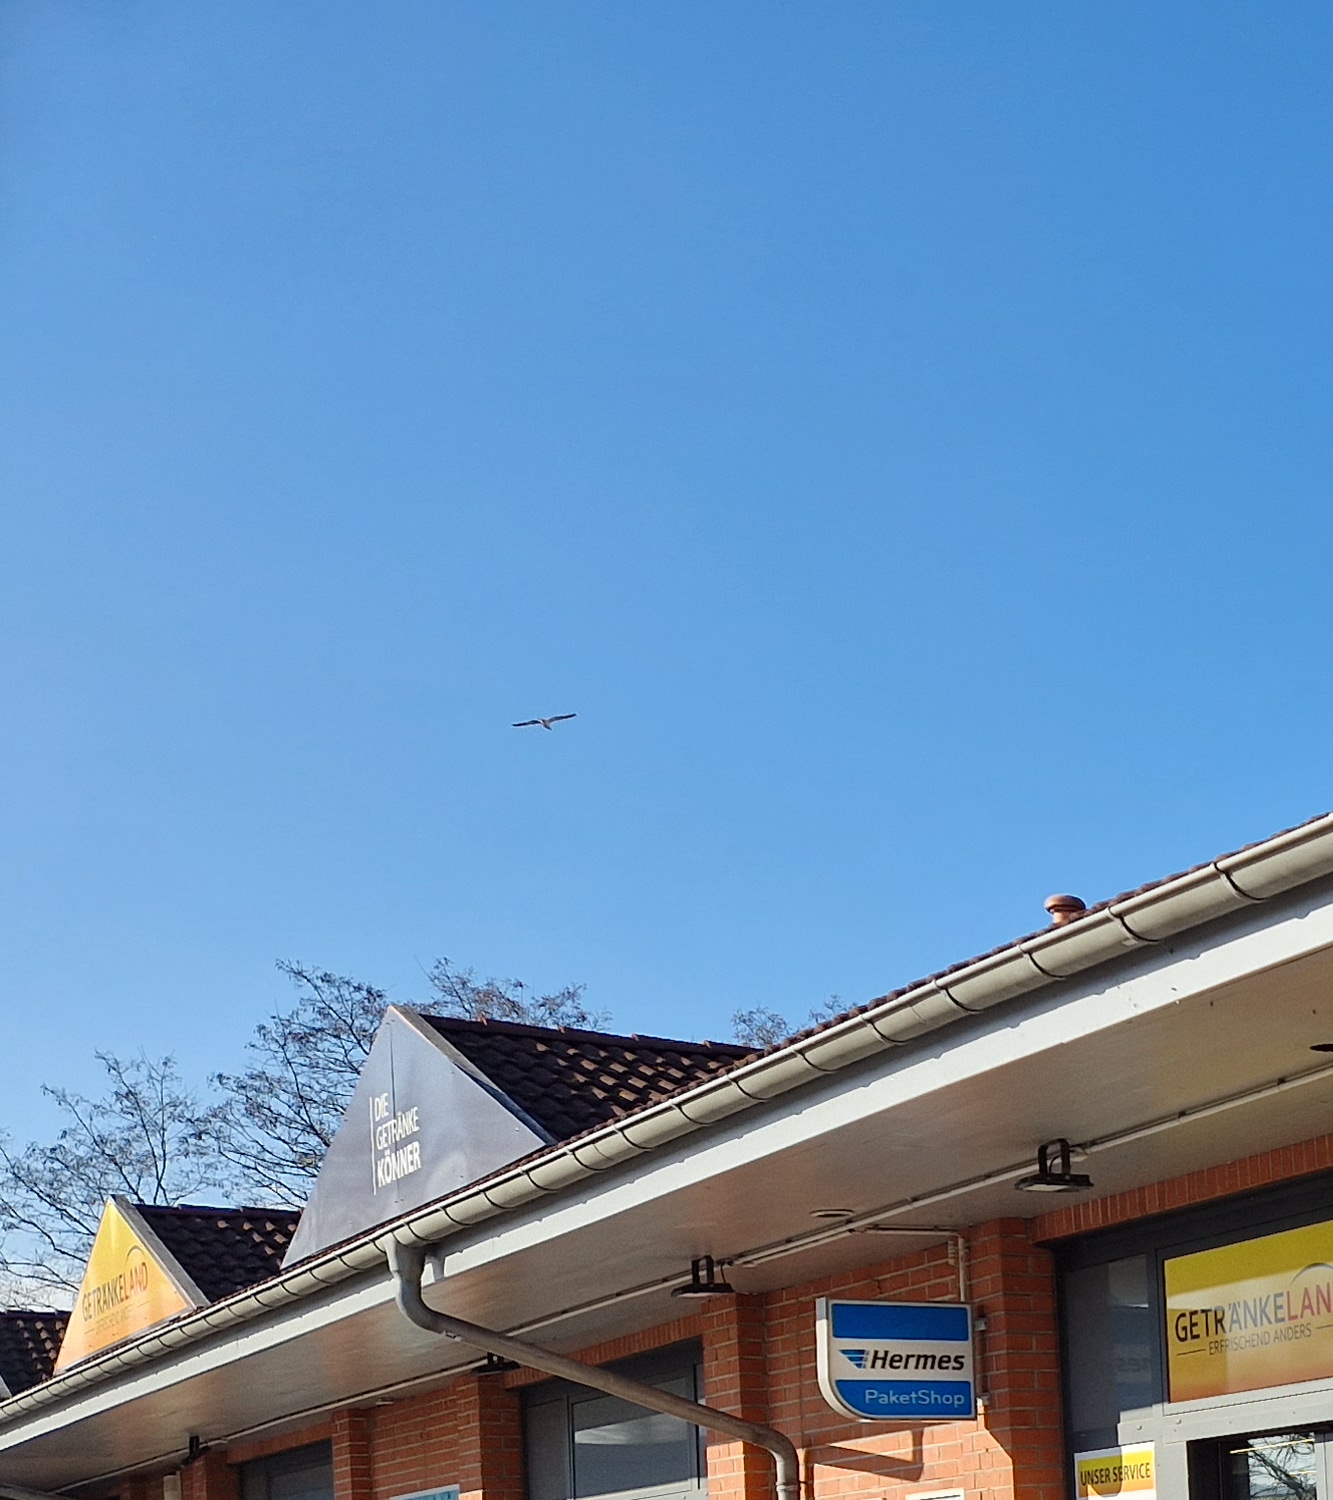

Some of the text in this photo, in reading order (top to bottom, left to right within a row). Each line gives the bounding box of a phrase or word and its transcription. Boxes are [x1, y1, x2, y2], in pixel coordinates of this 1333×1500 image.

[374, 1092, 389, 1121] DIE
[376, 1106, 420, 1150] GETRÄNKE
[377, 1140, 421, 1188] KÖNNER
[82, 1261, 148, 1322] GETRÄNKELAND
[1208, 1323, 1312, 1355] ERFRISCHEND ANDERS
[870, 1350, 965, 1371] Hermes
[865, 1390, 964, 1407] PaketShop
[1080, 1462, 1151, 1487] UNSER SERVICE
